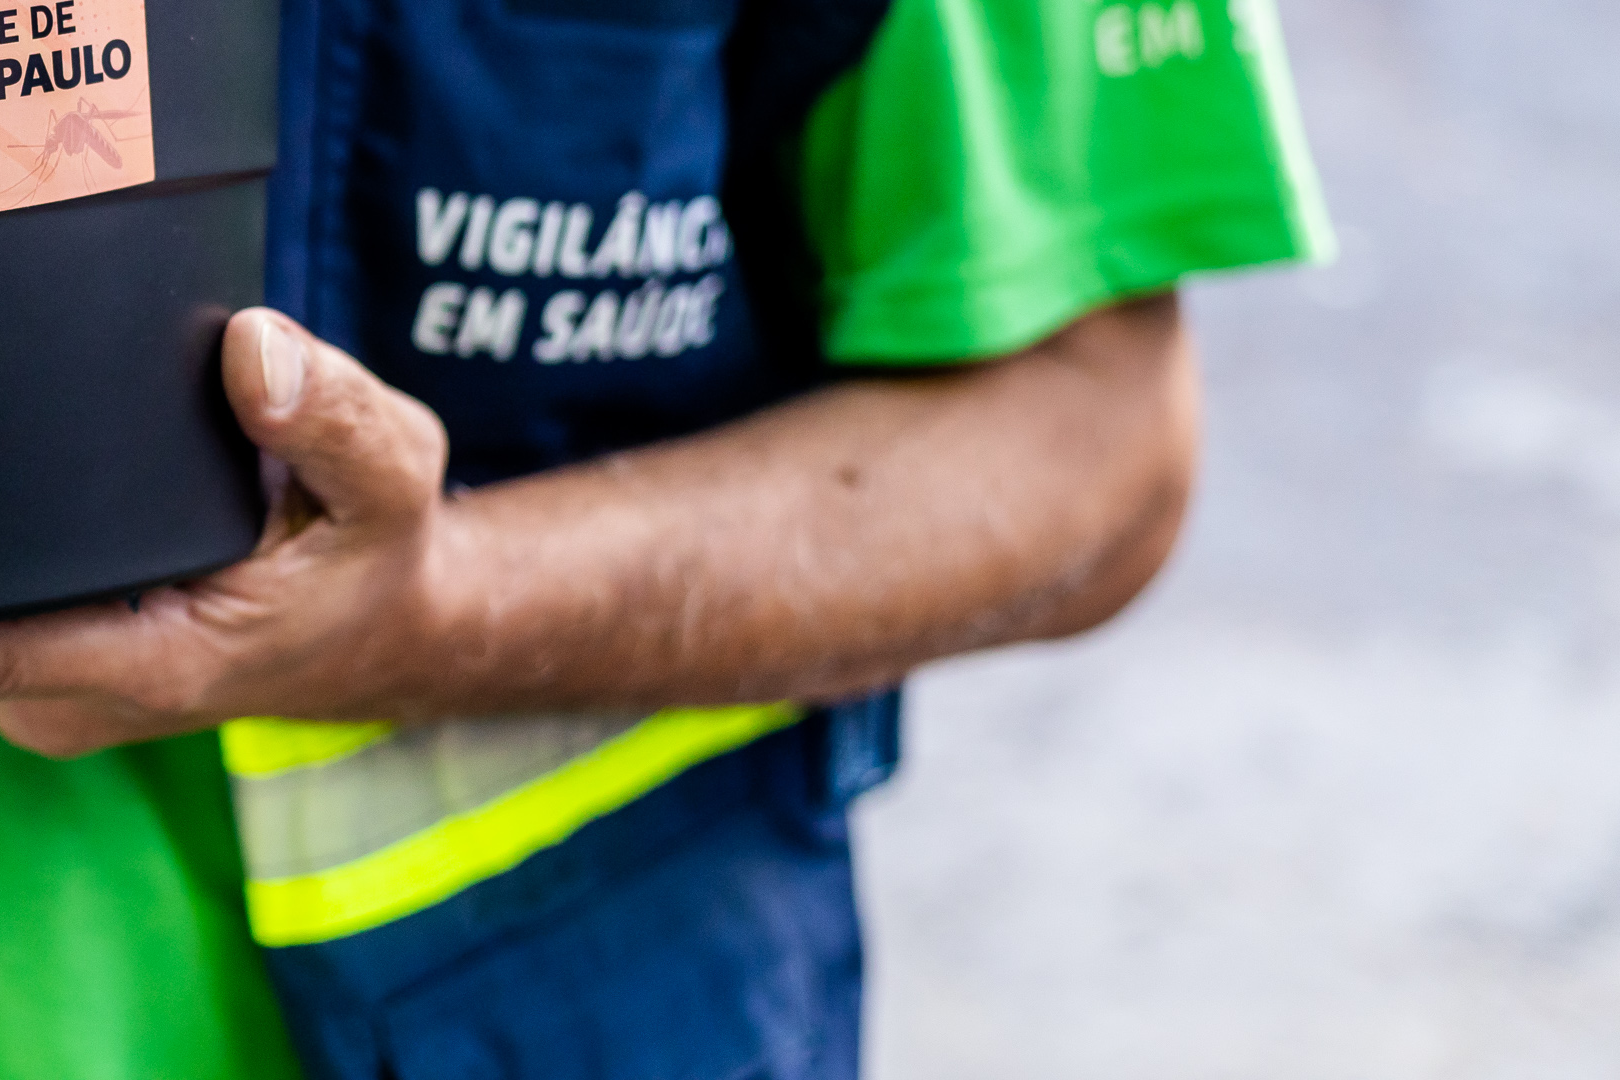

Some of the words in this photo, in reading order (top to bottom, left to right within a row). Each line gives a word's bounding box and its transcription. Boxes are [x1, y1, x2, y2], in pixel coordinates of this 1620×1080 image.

[30, 0, 77, 39] DE
[411, 281, 527, 363] EM
[532, 272, 726, 365] SAÚDE
